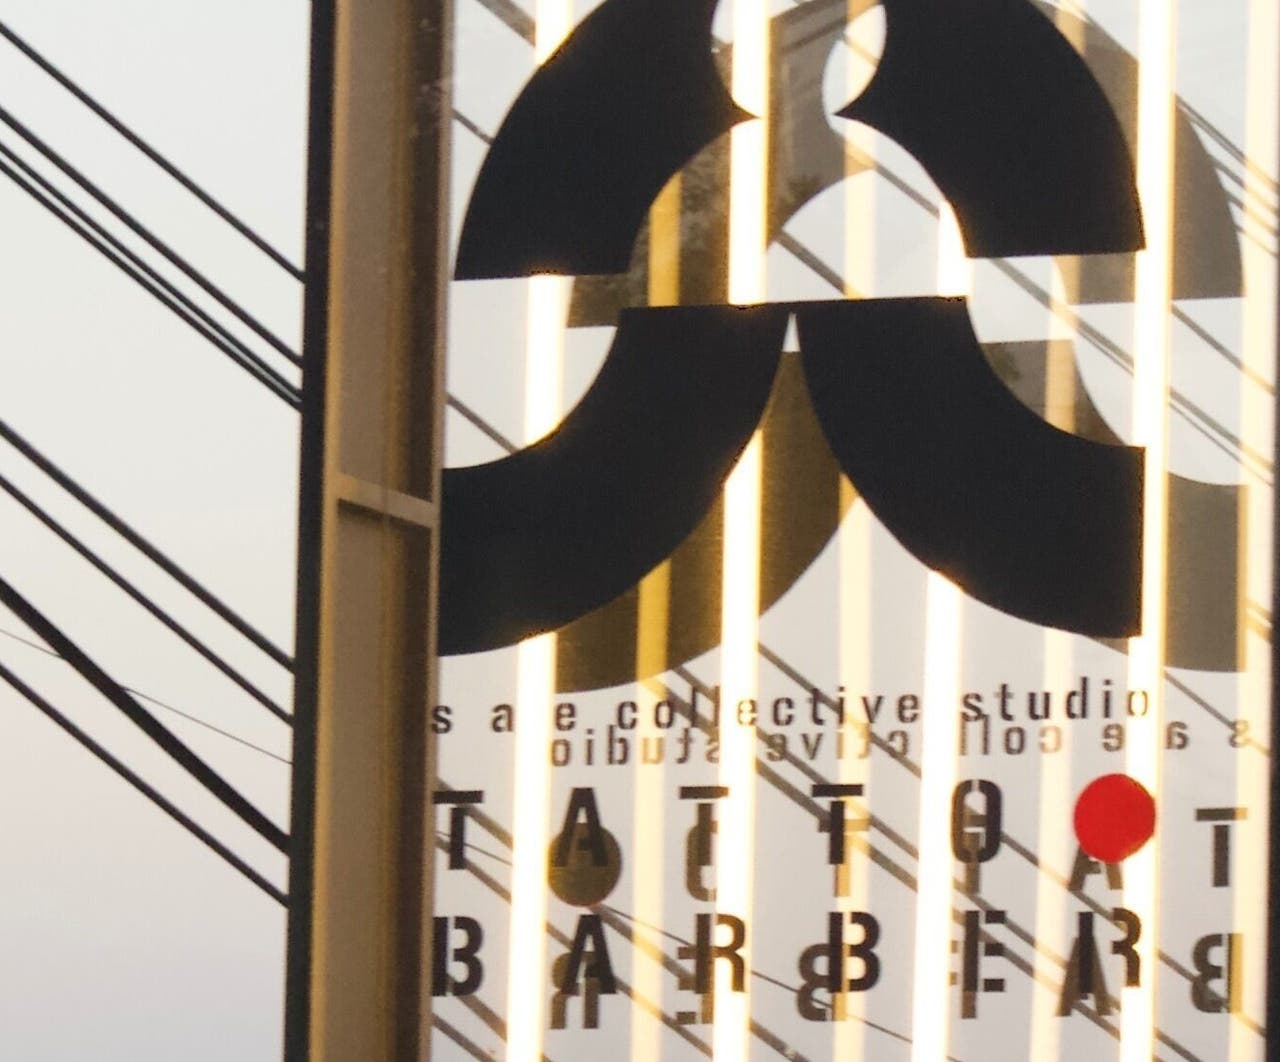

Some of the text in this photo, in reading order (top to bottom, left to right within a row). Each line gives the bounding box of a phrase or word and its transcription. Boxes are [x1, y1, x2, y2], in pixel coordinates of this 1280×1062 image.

[491, 702, 576, 733] ae
[617, 684, 920, 731] collective
[960, 676, 1149, 722] studio
[430, 906, 1141, 996] BARBER
